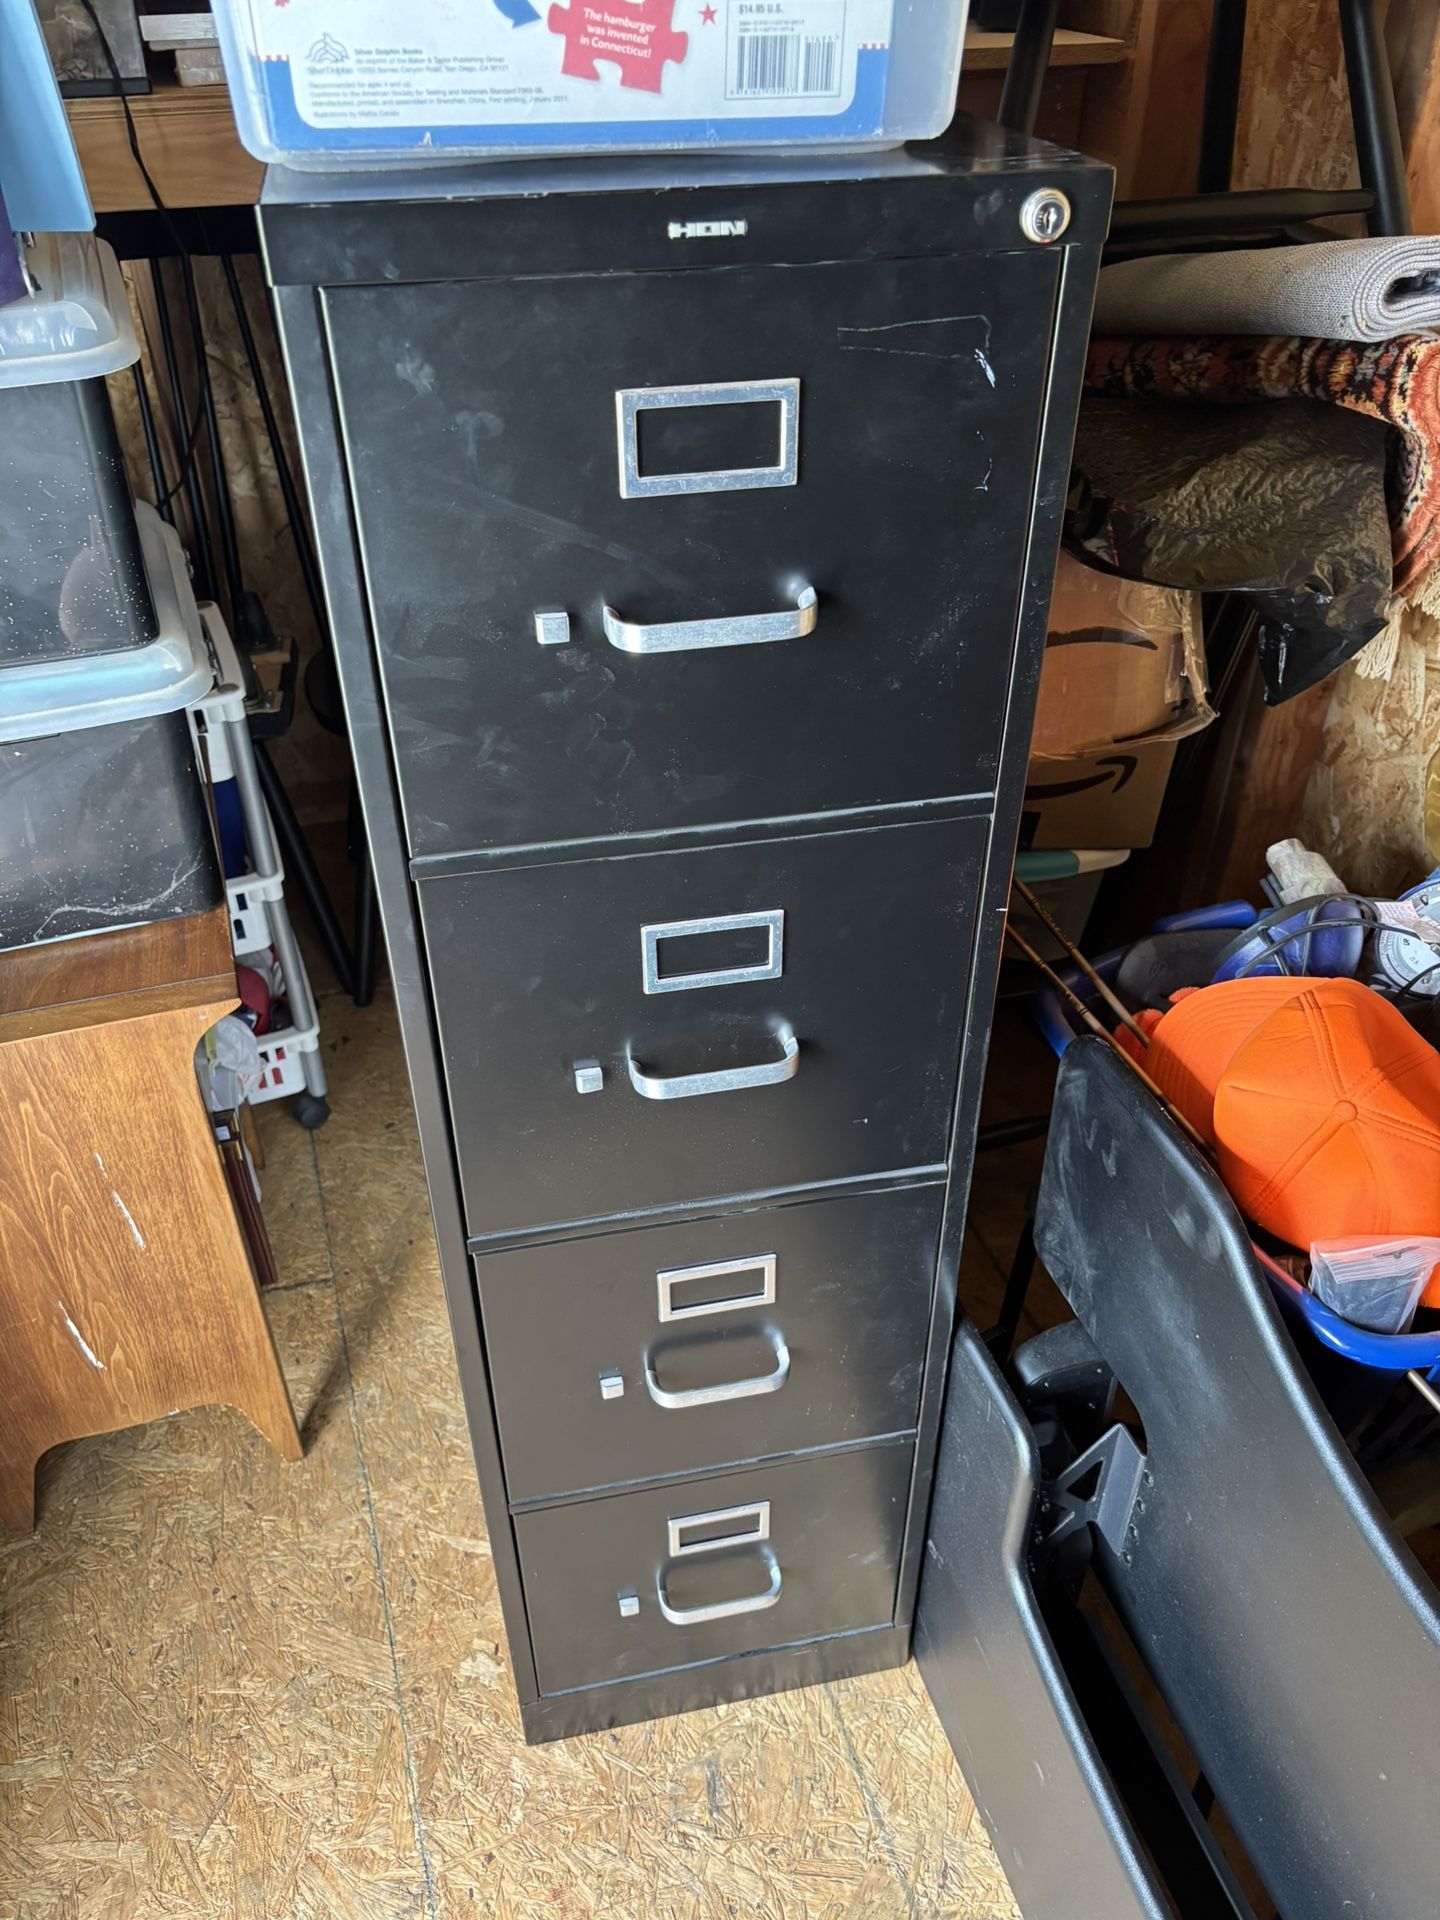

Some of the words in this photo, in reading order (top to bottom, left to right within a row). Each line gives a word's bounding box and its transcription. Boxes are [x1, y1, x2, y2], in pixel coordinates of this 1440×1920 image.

[767, 3, 784, 13] U.S.
[583, 7, 602, 22] The
[604, 12, 656, 34] hamburger
[587, 24, 605, 36] was
[608, 26, 649, 45] invented
[375, 48, 400, 56] Dolphin
[580, 33, 590, 46] in
[591, 36, 652, 59] Connecticut!
[667, 220, 748, 239] HON
